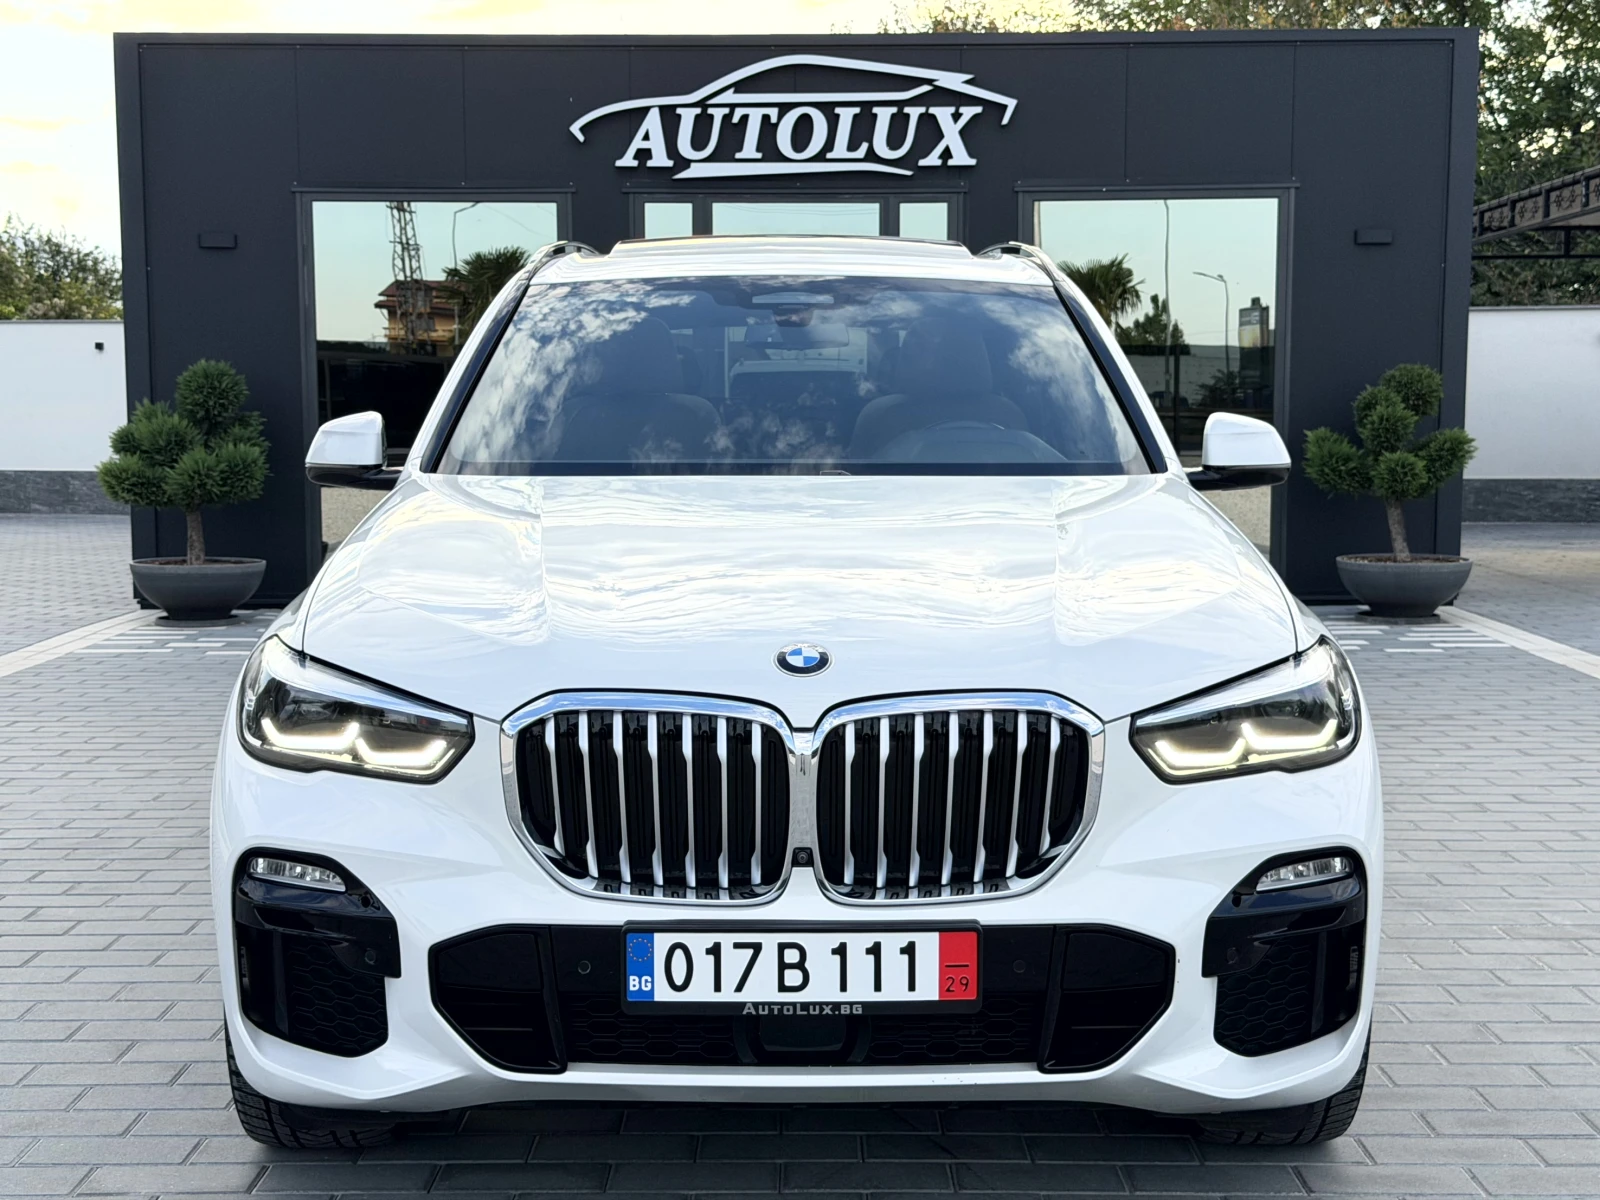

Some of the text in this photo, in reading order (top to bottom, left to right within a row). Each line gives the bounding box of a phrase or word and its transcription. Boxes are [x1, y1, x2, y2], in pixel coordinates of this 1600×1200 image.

[614, 105, 984, 168] AUTOLUX
[628, 975, 652, 992] BG
[944, 976, 970, 993] 29
